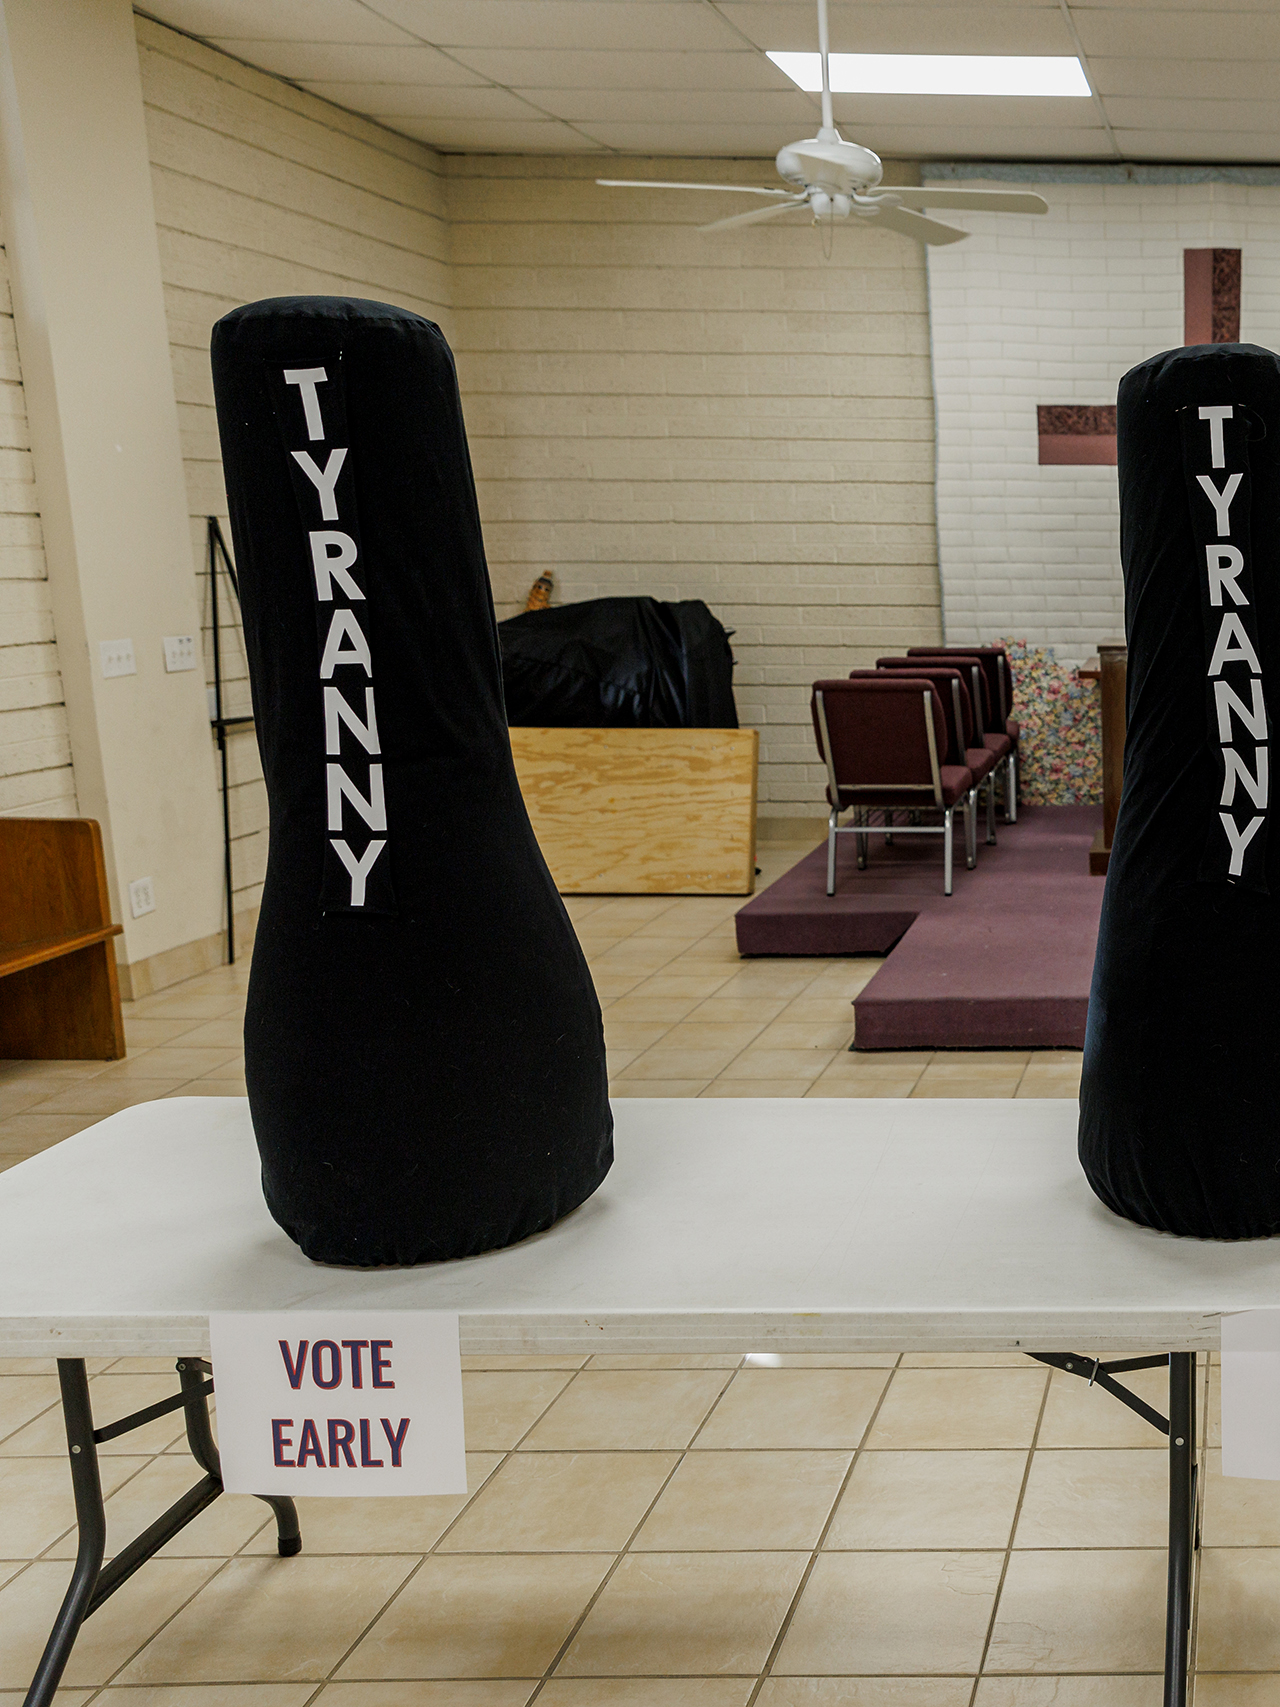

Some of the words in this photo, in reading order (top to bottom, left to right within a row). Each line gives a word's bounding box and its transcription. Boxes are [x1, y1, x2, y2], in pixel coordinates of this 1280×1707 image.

[283, 367, 388, 907] TYRANNY
[1195, 405, 1269, 877] TYRANNY
[271, 1417, 411, 1468] EARLY
[278, 1339, 396, 1390] VOTE
